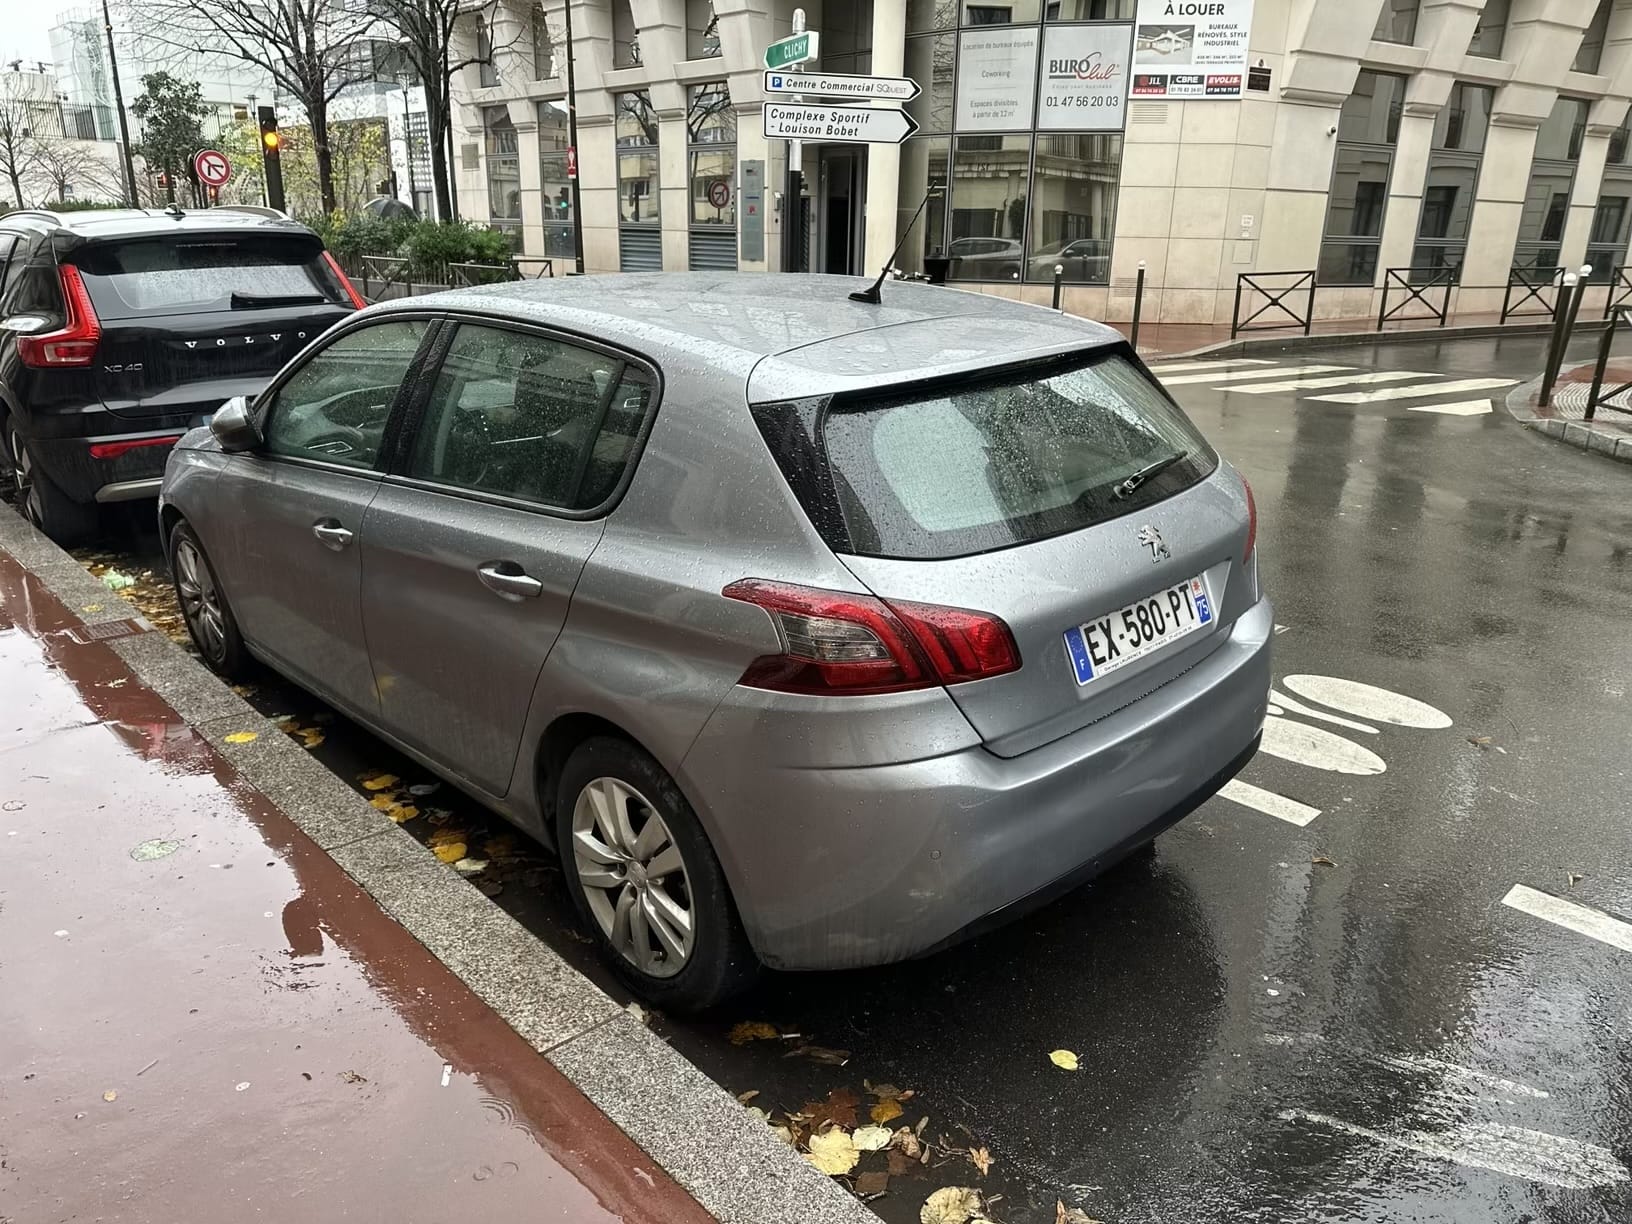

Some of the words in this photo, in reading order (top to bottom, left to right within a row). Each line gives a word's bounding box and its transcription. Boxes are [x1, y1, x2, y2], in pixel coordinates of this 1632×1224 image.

[1178, 3, 1225, 16] LOUER
[784, 40, 807, 59] CLICHY
[1203, 39, 1240, 47] INDUSTRIEL
[981, 70, 1011, 78] Coworking
[1149, 76, 1161, 85] JLL
[1175, 75, 1199, 84] CBRE
[786, 78, 817, 89] Centre
[820, 80, 875, 92] Commercial
[970, 100, 993, 108] Espaces
[1046, 96, 1059, 107] 01
[1061, 96, 1074, 107] 47
[1076, 96, 1089, 107] 56
[1090, 96, 1103, 107] 20
[1105, 96, 1119, 107] 03
[770, 108, 825, 122] Complexe
[830, 111, 871, 124] Sportif
[977, 111, 992, 119] partir
[992, 110, 999, 118] de
[778, 123, 822, 135] Louison
[826, 124, 859, 137] Bobet
[184, 331, 306, 349] VOLVO
[1196, 598, 1209, 617] 75
[1084, 584, 1195, 666] EX-580-PT
[1079, 658, 1085, 671] F
